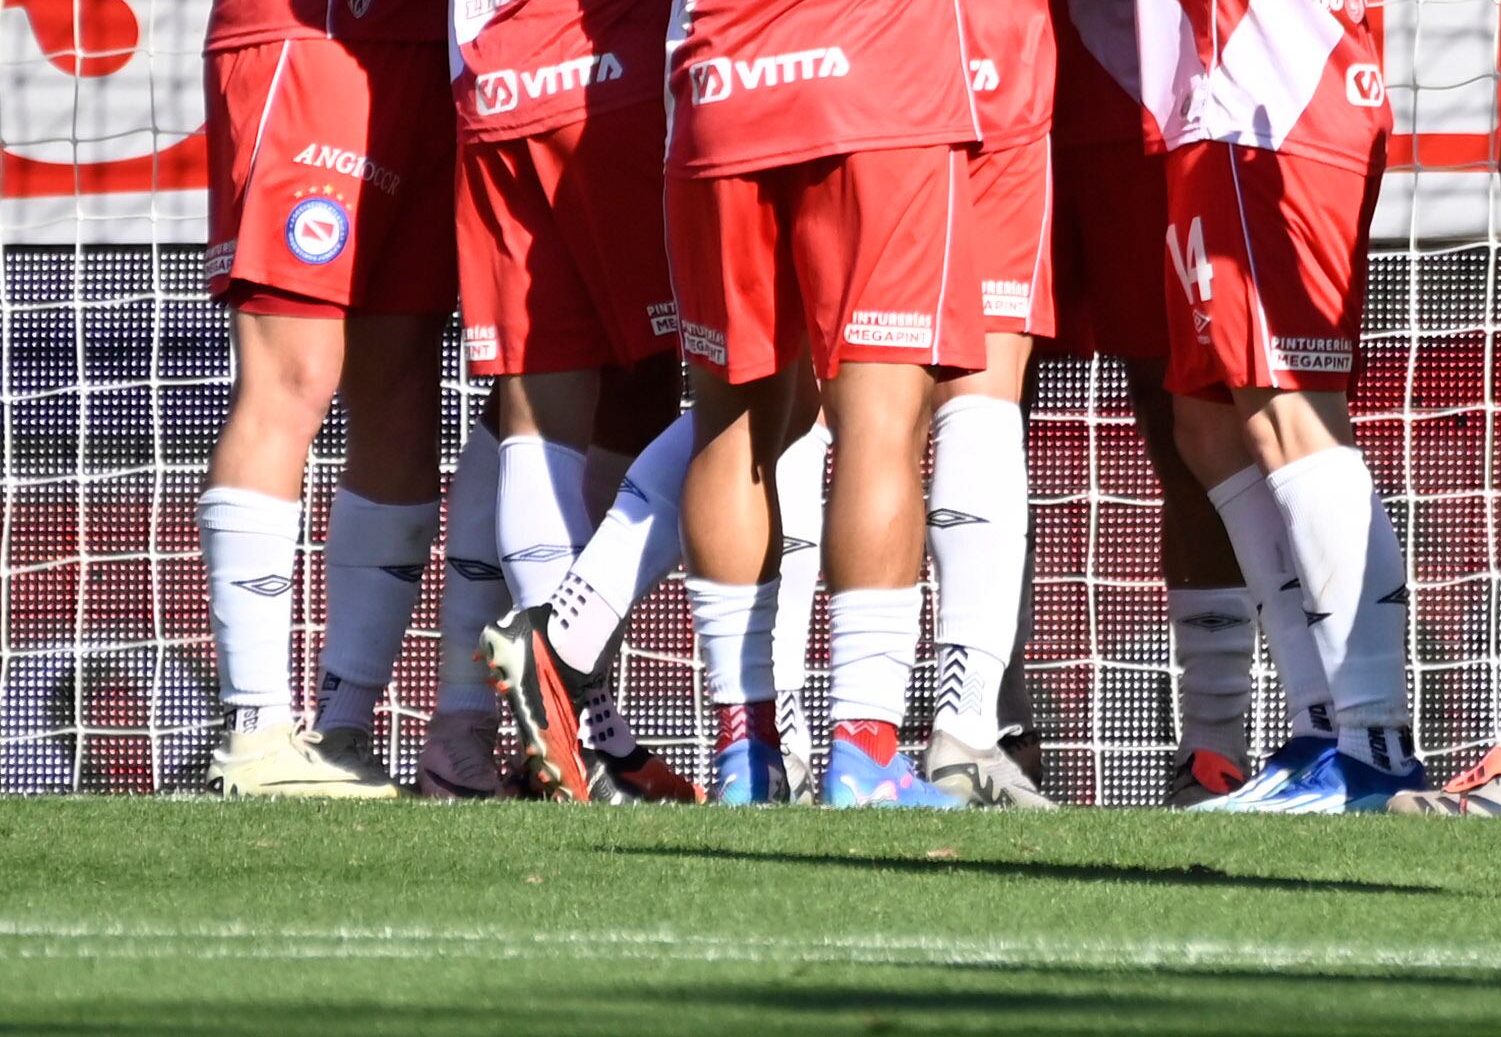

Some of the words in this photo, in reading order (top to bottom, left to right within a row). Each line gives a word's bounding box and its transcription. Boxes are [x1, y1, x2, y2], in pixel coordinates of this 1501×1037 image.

[519, 52, 624, 99] VITTA
[735, 46, 851, 90] VITTA
[293, 143, 401, 196] ANGIOCOR
[1165, 215, 1213, 305] 14
[847, 328, 927, 343] MEGAPINT
[852, 310, 932, 328] INTURERÍAS
